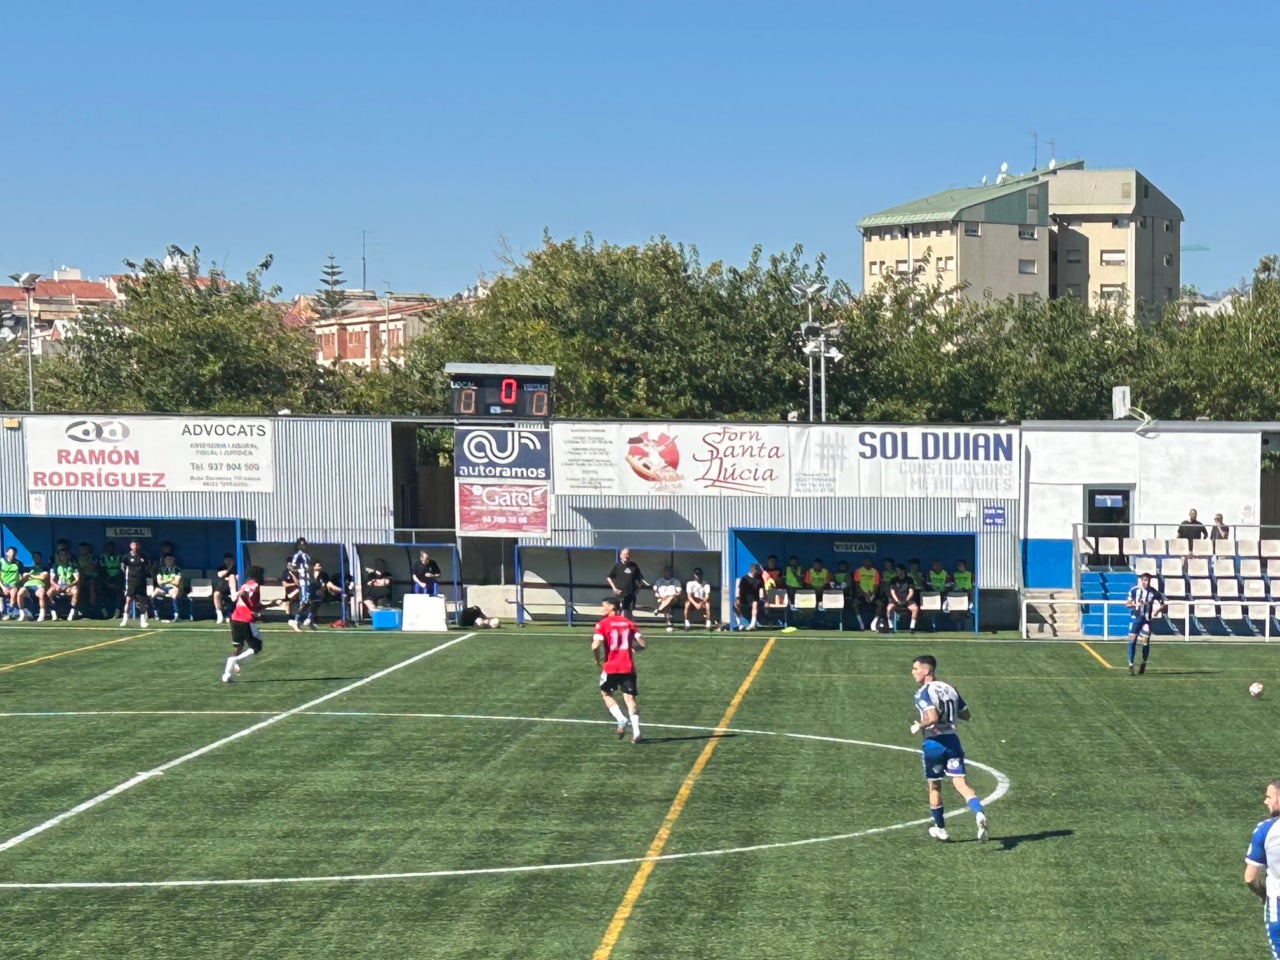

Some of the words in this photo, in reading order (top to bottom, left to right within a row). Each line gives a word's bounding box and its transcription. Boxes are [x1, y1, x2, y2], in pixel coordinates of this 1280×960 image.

[500, 378, 517, 404] 0
[181, 423, 266, 437] ADVOCATS
[712, 426, 761, 443] Forn
[57, 446, 140, 465] RAMÓN
[693, 432, 784, 461] Santa
[208, 462, 223, 471] 937
[460, 465, 546, 478] autoramos
[33, 468, 167, 488] RODRÍGUEZ
[113, 528, 145, 536] LOCAL
[610, 629, 630, 651] 11
